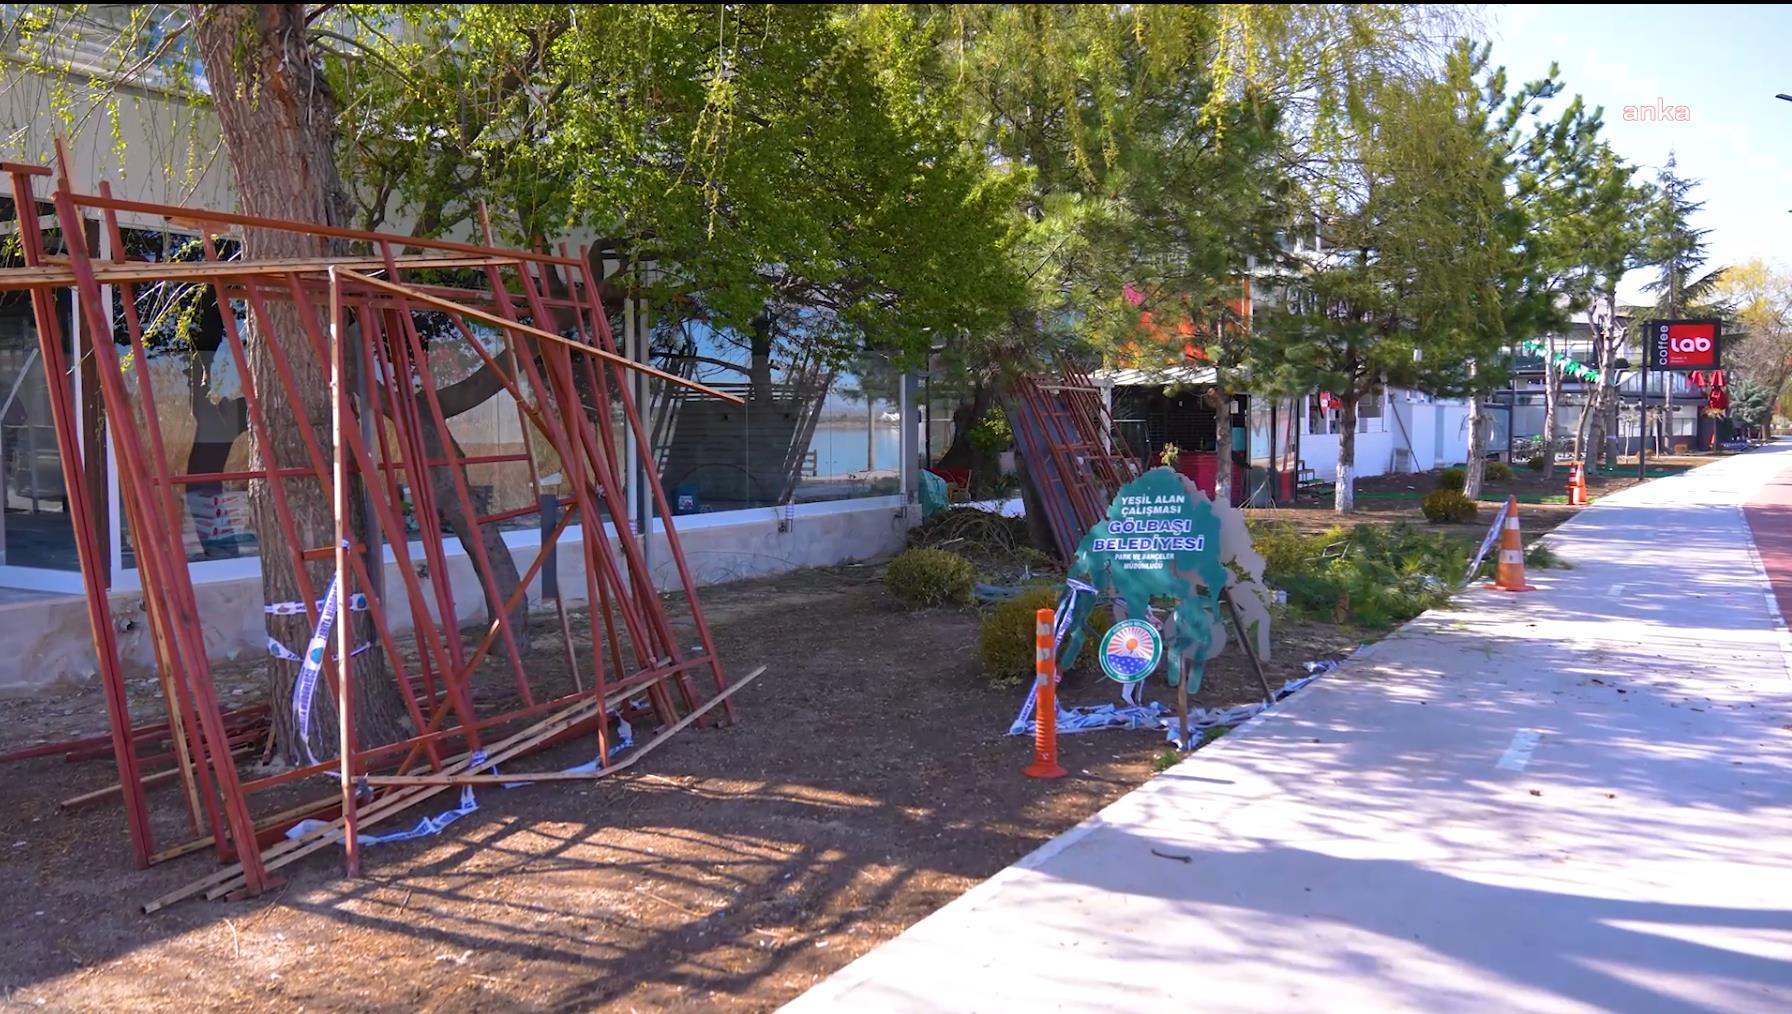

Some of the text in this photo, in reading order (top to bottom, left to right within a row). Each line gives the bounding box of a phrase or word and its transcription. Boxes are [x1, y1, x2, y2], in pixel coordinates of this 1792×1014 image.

[1658, 325, 1669, 365] coffee
[1121, 494, 1185, 506] YEŞİL ALAN
[1121, 505, 1181, 517] ÇALIŞMASI
[1108, 517, 1192, 535] GÖLBAŞI
[1092, 534, 1205, 551] BELEDİYESİ
